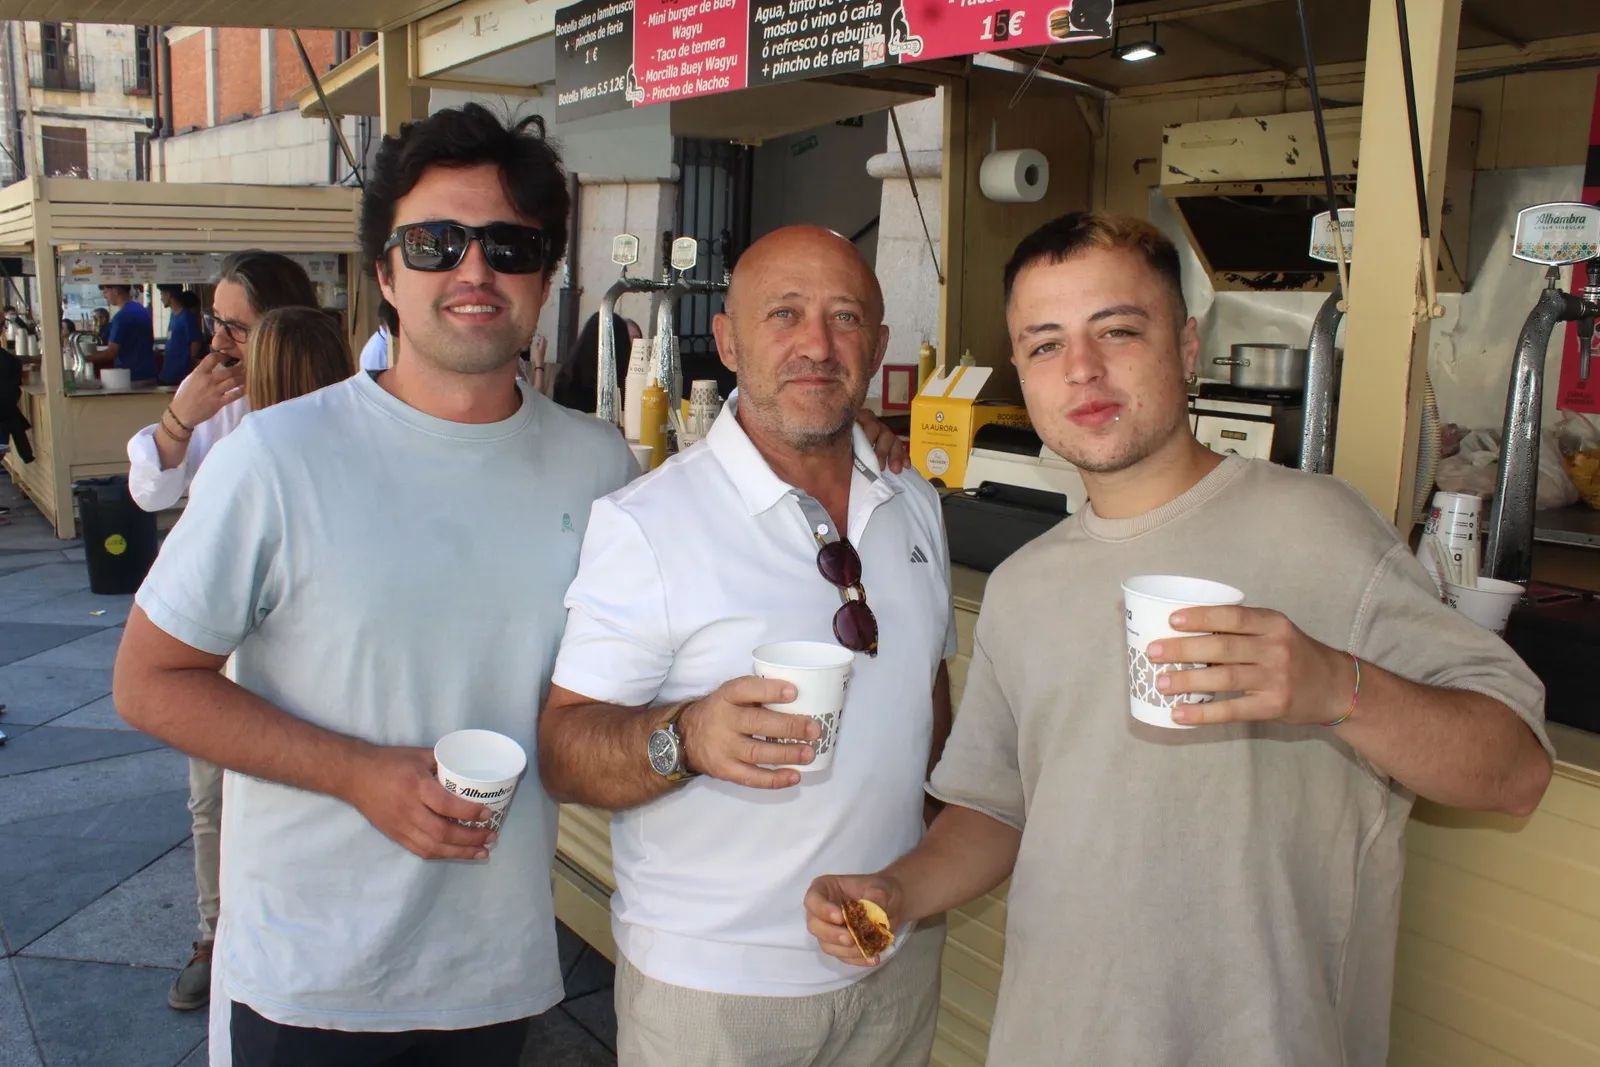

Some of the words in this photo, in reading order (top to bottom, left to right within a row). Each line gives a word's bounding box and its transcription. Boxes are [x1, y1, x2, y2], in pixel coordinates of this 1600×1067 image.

[556, 21, 578, 37] Botella
[578, 14, 592, 29] sidra
[592, 14, 596, 22] o
[596, 0, 634, 20] lambrusco
[648, 10, 667, 27] Mini
[668, 4, 698, 22] burger
[699, 0, 711, 14] de
[755, 5, 785, 24] Agua,
[763, 19, 798, 39] mosto
[800, 13, 808, 31] ó
[811, 11, 837, 29] vino
[839, 4, 848, 23] ó
[851, 0, 882, 21] caña
[575, 31, 597, 51] pinchos
[597, 25, 606, 39] de
[607, 19, 624, 36] feria
[672, 23, 703, 40] Wagyu
[762, 41, 769, 58] ó
[771, 36, 818, 57] refresco
[820, 28, 829, 47] ó
[831, 22, 883, 46] rebujito
[656, 48, 677, 62] Taco
[678, 43, 690, 57] de
[691, 36, 726, 55] ternera
[761, 63, 770, 77] +
[772, 55, 811, 80] pincho
[813, 51, 829, 69] de
[831, 45, 860, 66] feria
[645, 65, 678, 84] Morcilla
[680, 60, 704, 77] Buey
[705, 54, 738, 72] Wagyu
[558, 90, 579, 106] Botella
[609, 75, 626, 93] 12€
[652, 82, 680, 101] Pincho
[682, 80, 694, 96] de
[695, 75, 730, 93] Nachos
[1536, 213, 1587, 225] Alhambra
[930, 424, 959, 433] AURORA
